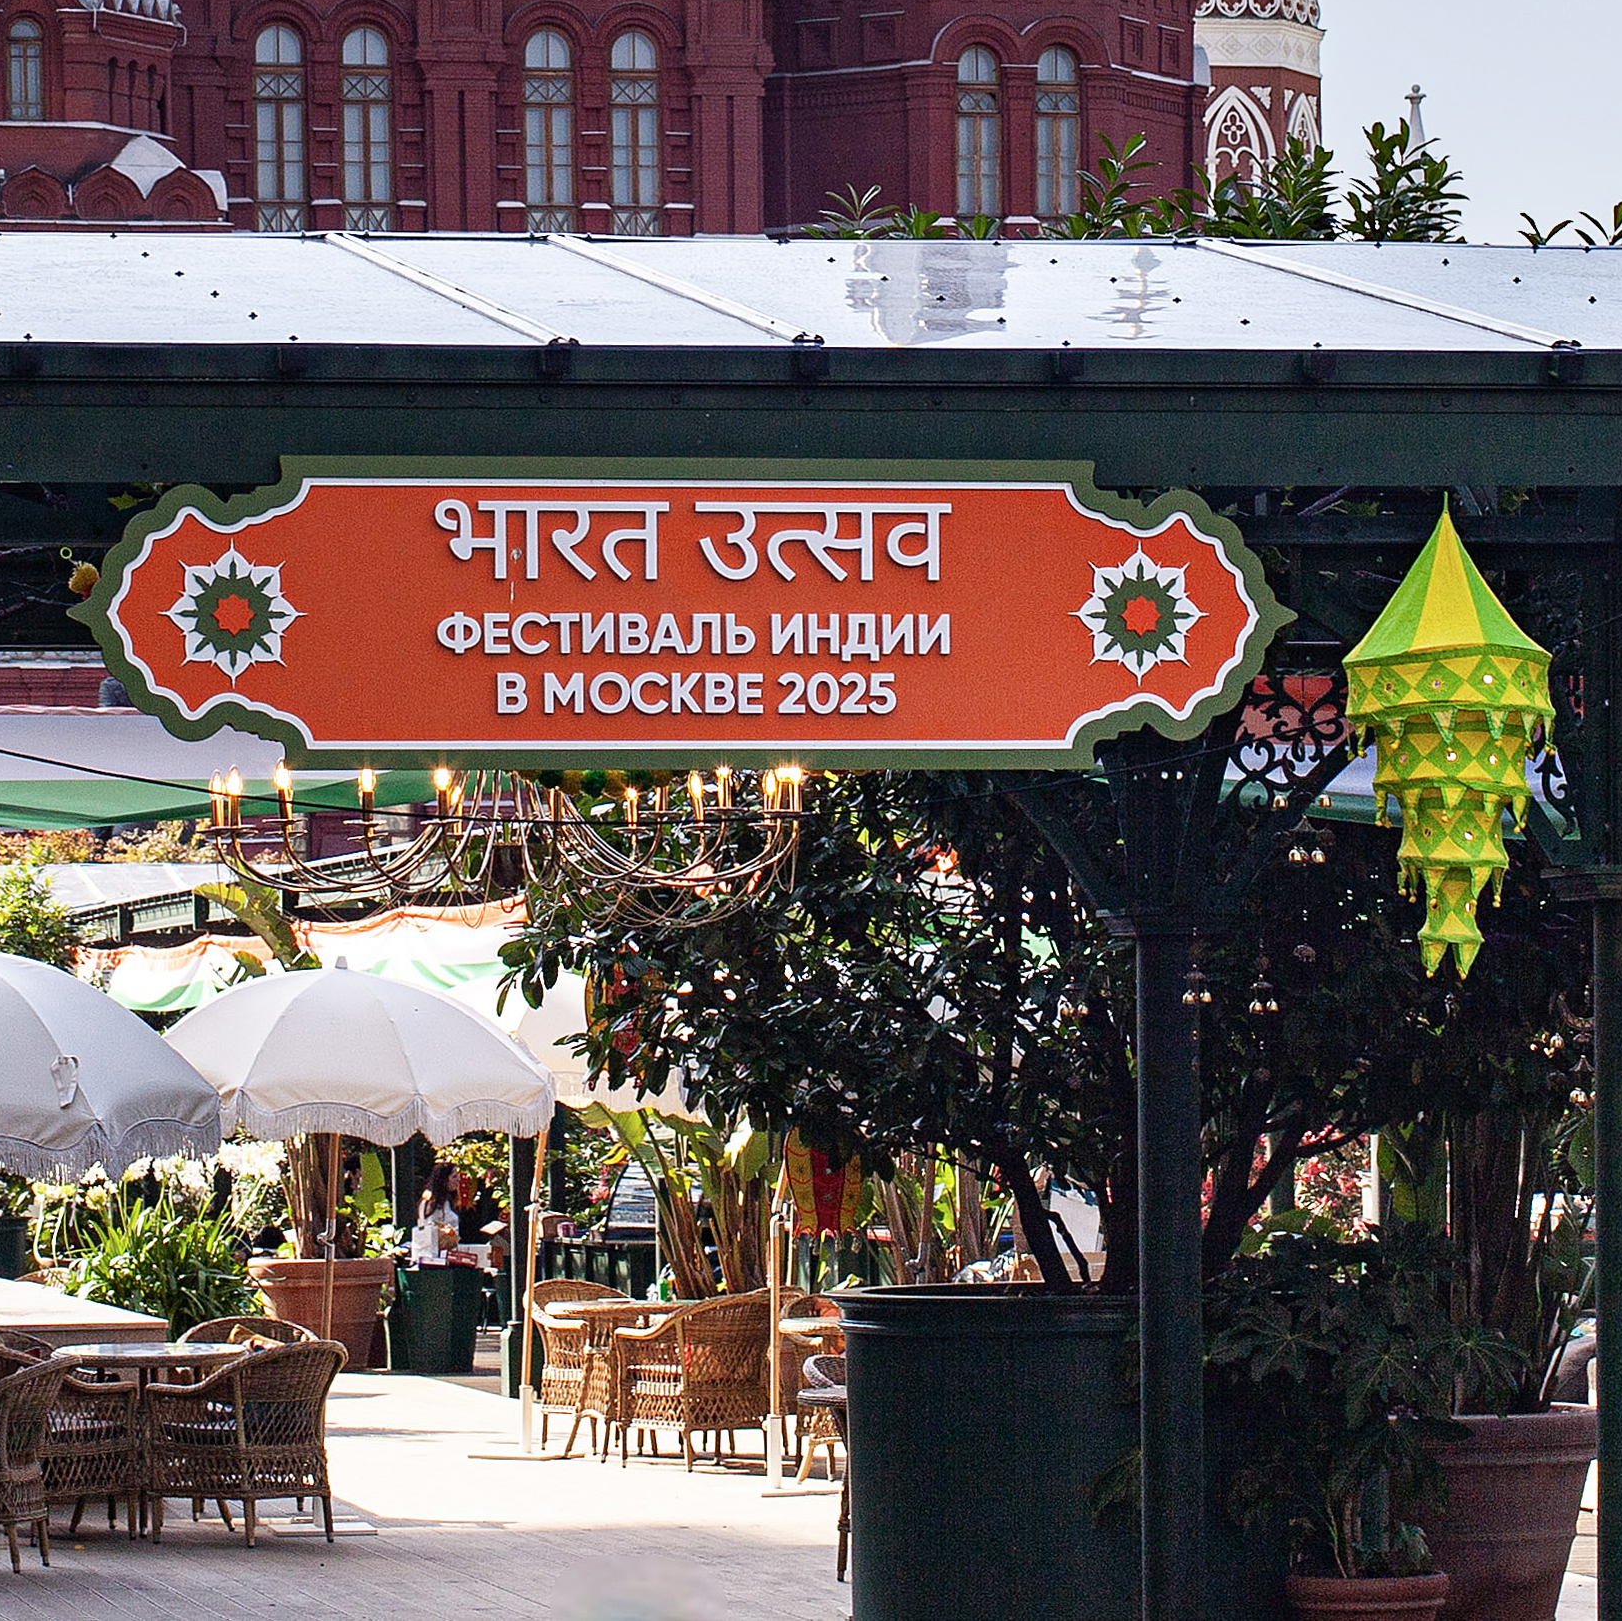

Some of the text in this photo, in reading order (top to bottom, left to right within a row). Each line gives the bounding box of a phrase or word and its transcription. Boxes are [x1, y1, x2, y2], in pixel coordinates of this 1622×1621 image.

[434, 499, 953, 581] भारत उत्सव
[436, 610, 951, 661] ФЕСТИВАЛЬ ИНДИИ
[497, 671, 897, 714] В МОСКВЕ 2025
